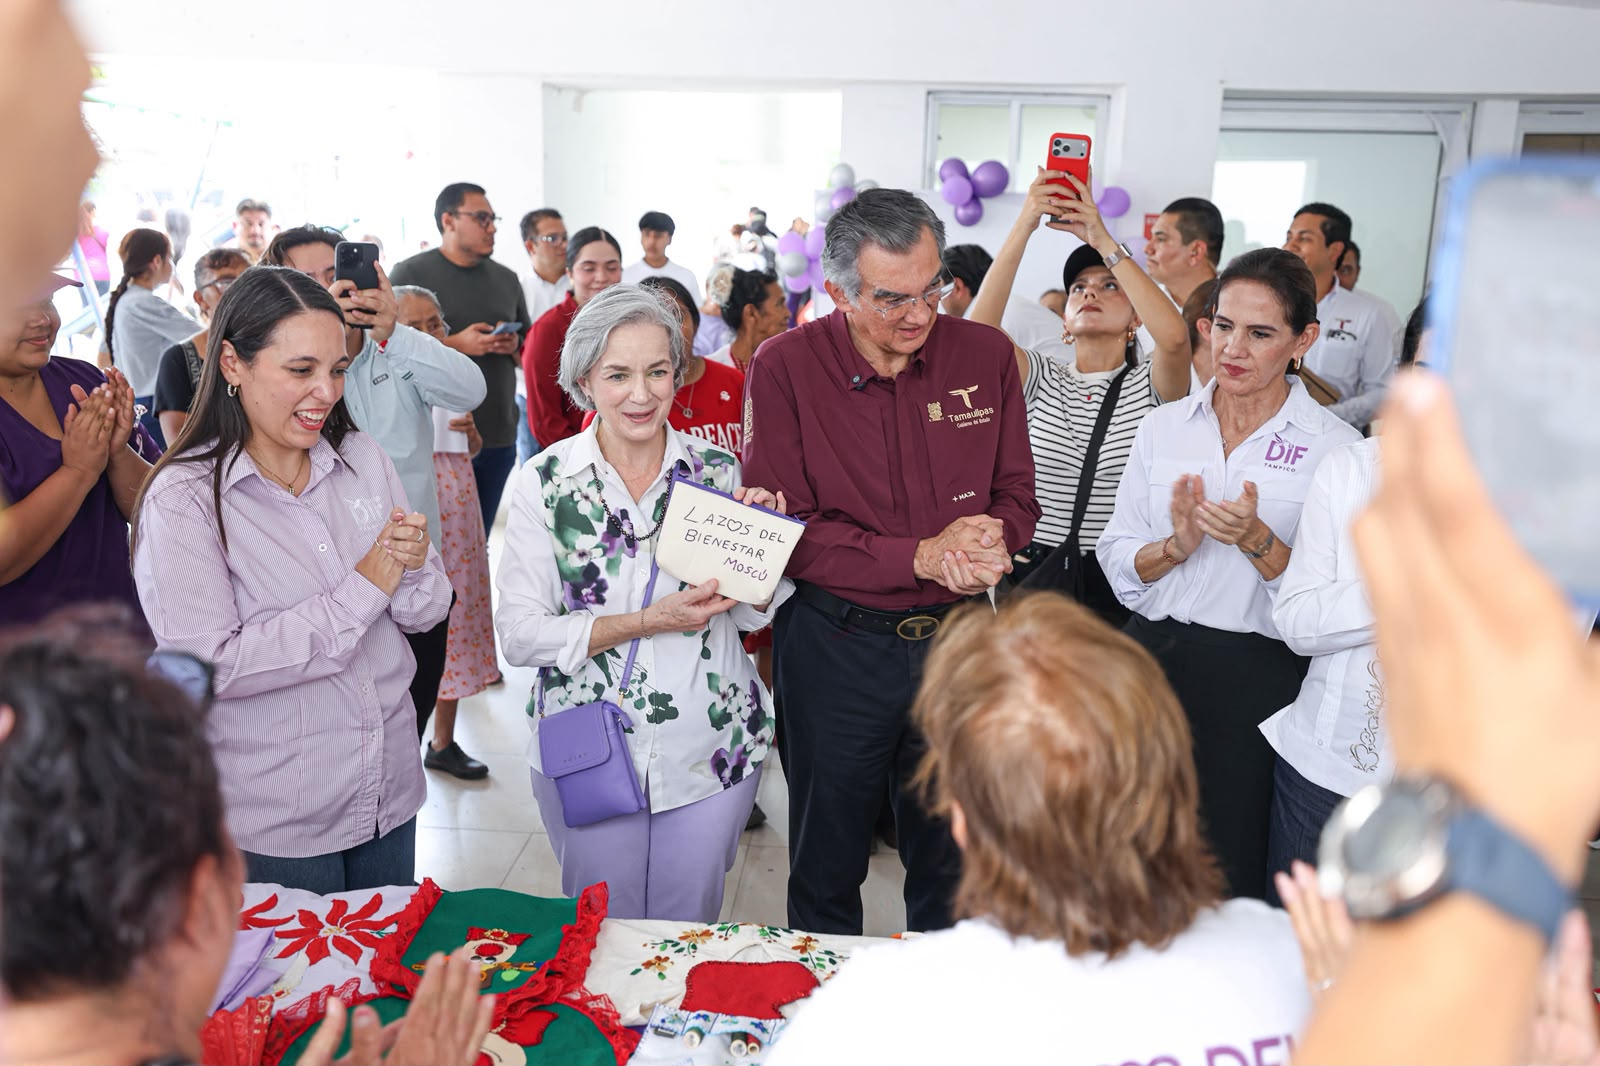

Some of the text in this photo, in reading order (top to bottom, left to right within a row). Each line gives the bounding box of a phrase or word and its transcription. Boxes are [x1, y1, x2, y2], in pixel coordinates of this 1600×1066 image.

[947, 407, 994, 423] Tamaulipas
[1265, 440, 1309, 465] DIF
[1264, 462, 1297, 473] TAMPICO
[684, 528, 765, 561] BIENESTAR
[759, 529, 786, 543] DEL
[723, 557, 768, 581] MOSCÚ
